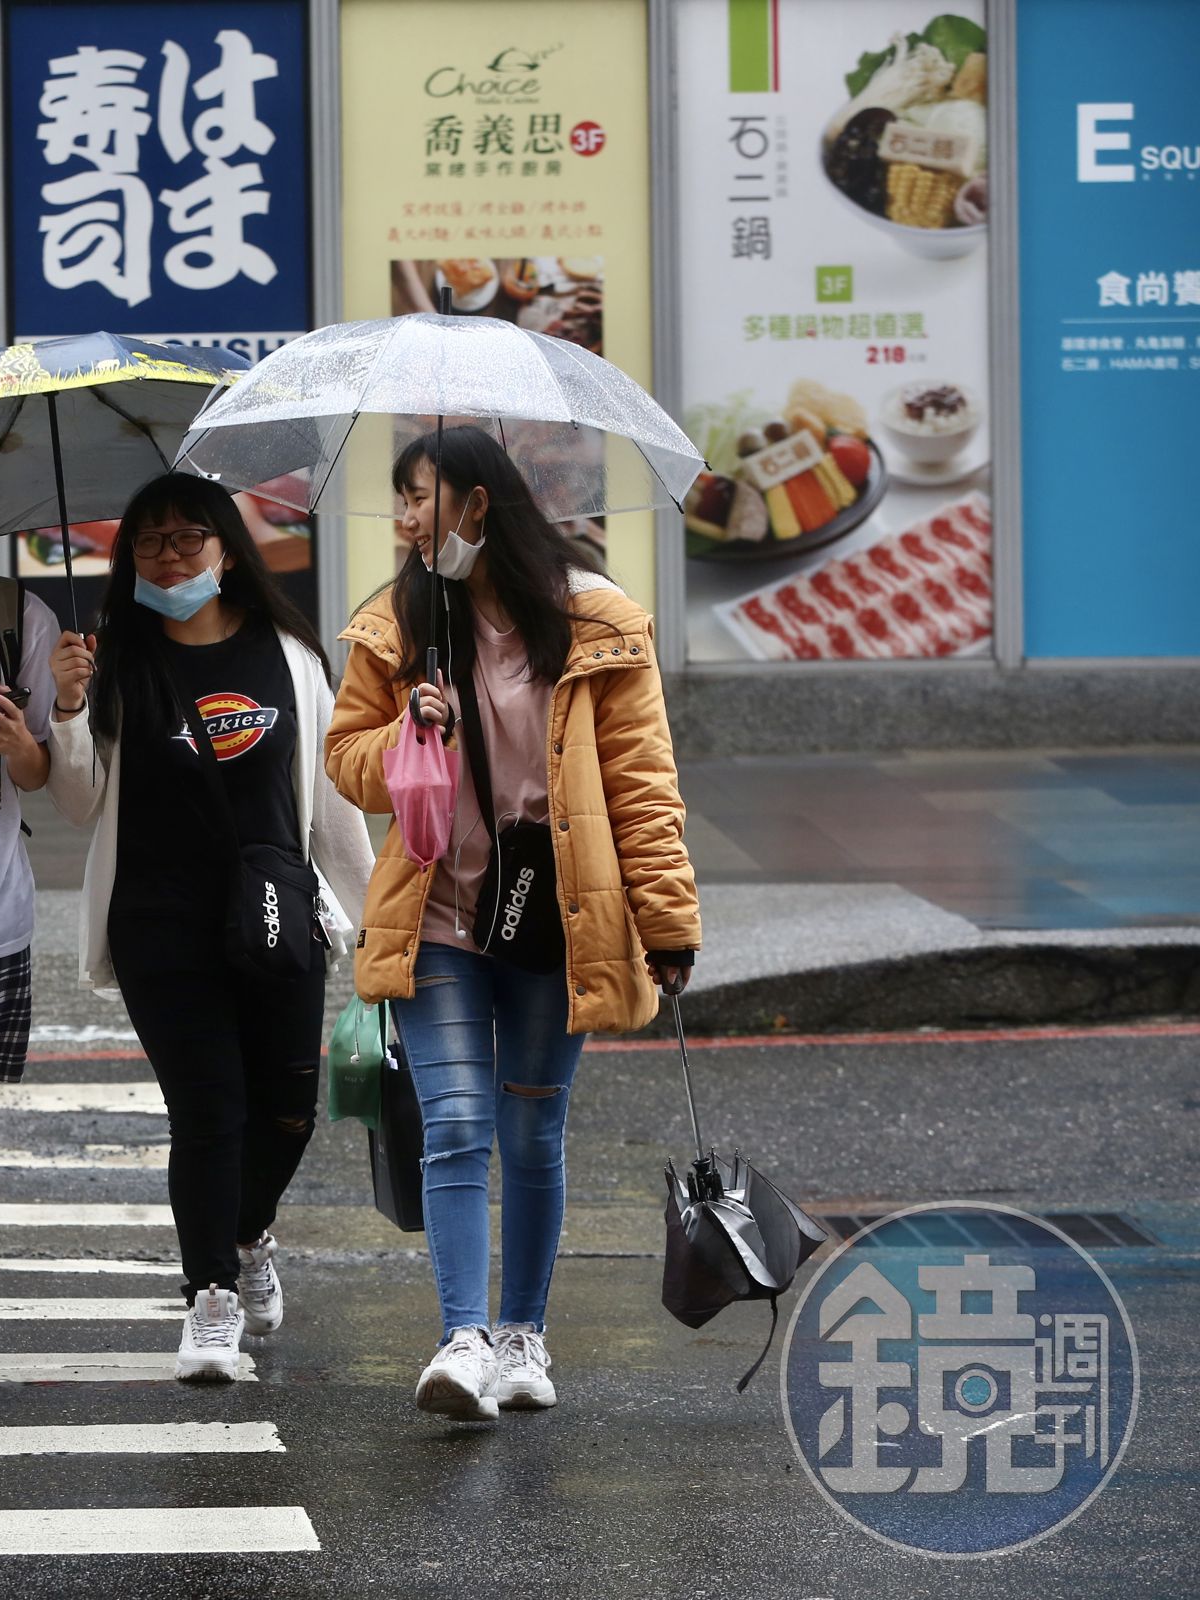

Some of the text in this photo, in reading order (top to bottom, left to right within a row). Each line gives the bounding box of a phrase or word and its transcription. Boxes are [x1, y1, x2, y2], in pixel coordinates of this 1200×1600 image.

[424, 67, 541, 98] Choice
[425, 113, 564, 156] 喬義思
[573, 129, 606, 152] 3F
[36, 46, 154, 308] 寿司
[158, 29, 279, 290] はま
[728, 115, 771, 261] 石二鍋
[821, 275, 848, 295] 3F
[866, 346, 907, 364] 218
[181, 714, 266, 735] ckies
[262, 881, 280, 948] adidas
[501, 867, 535, 941] adidas
